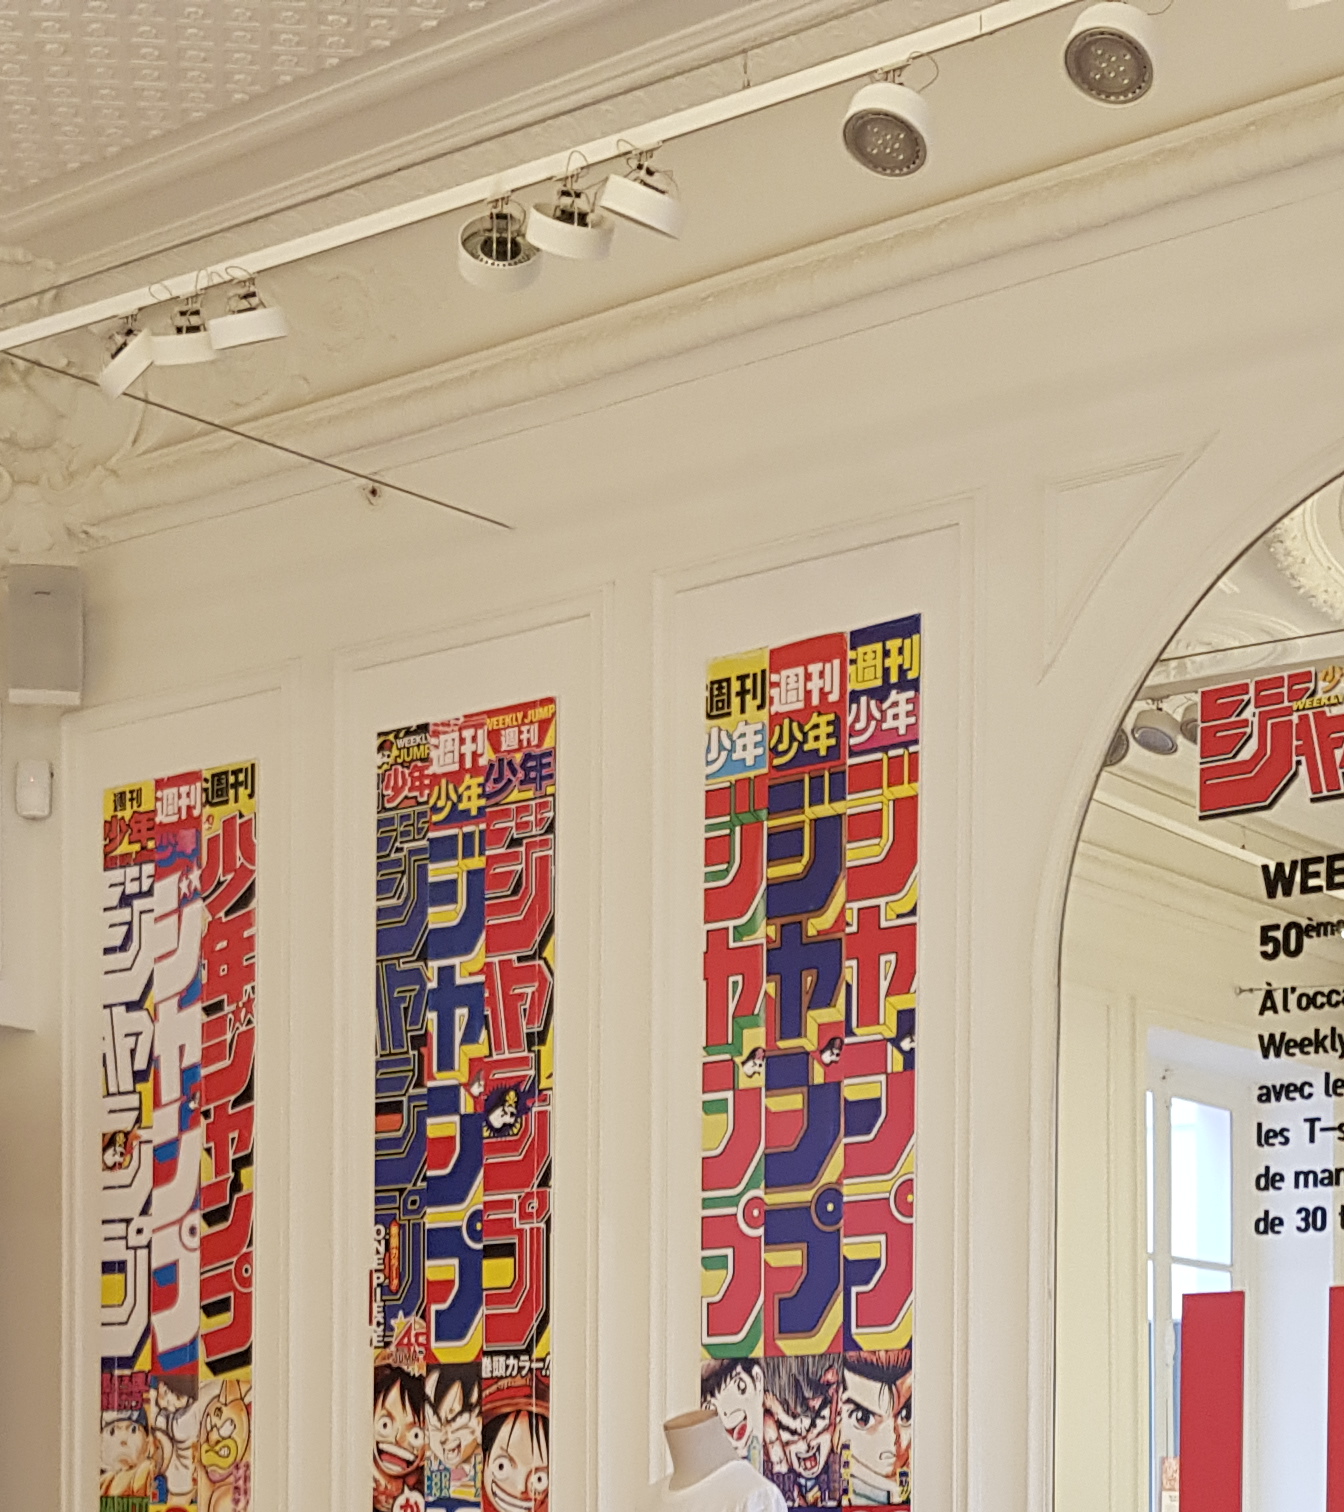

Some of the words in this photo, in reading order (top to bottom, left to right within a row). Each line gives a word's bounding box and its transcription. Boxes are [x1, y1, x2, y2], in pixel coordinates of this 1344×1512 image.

[849, 633, 921, 690] 週刊
[706, 668, 766, 720] 週刊
[769, 659, 841, 714] 週刊
[500, 723, 539, 751] 週刊
[769, 711, 837, 766] 少年
[848, 689, 918, 746] 少年
[428, 726, 488, 774] 週刊
[705, 720, 765, 776] 少年
[203, 763, 256, 808] 週刊
[429, 773, 486, 823] 少年
[483, 750, 555, 804] 少年
[156, 782, 202, 825] 週刊
[1258, 982, 1280, 1016] À
[1256, 1079, 1314, 1105] avec
[1255, 1121, 1291, 1149] les
[1254, 1163, 1286, 1193] de
[1253, 1208, 1285, 1236] de
[1294, 1204, 1328, 1234] 30
